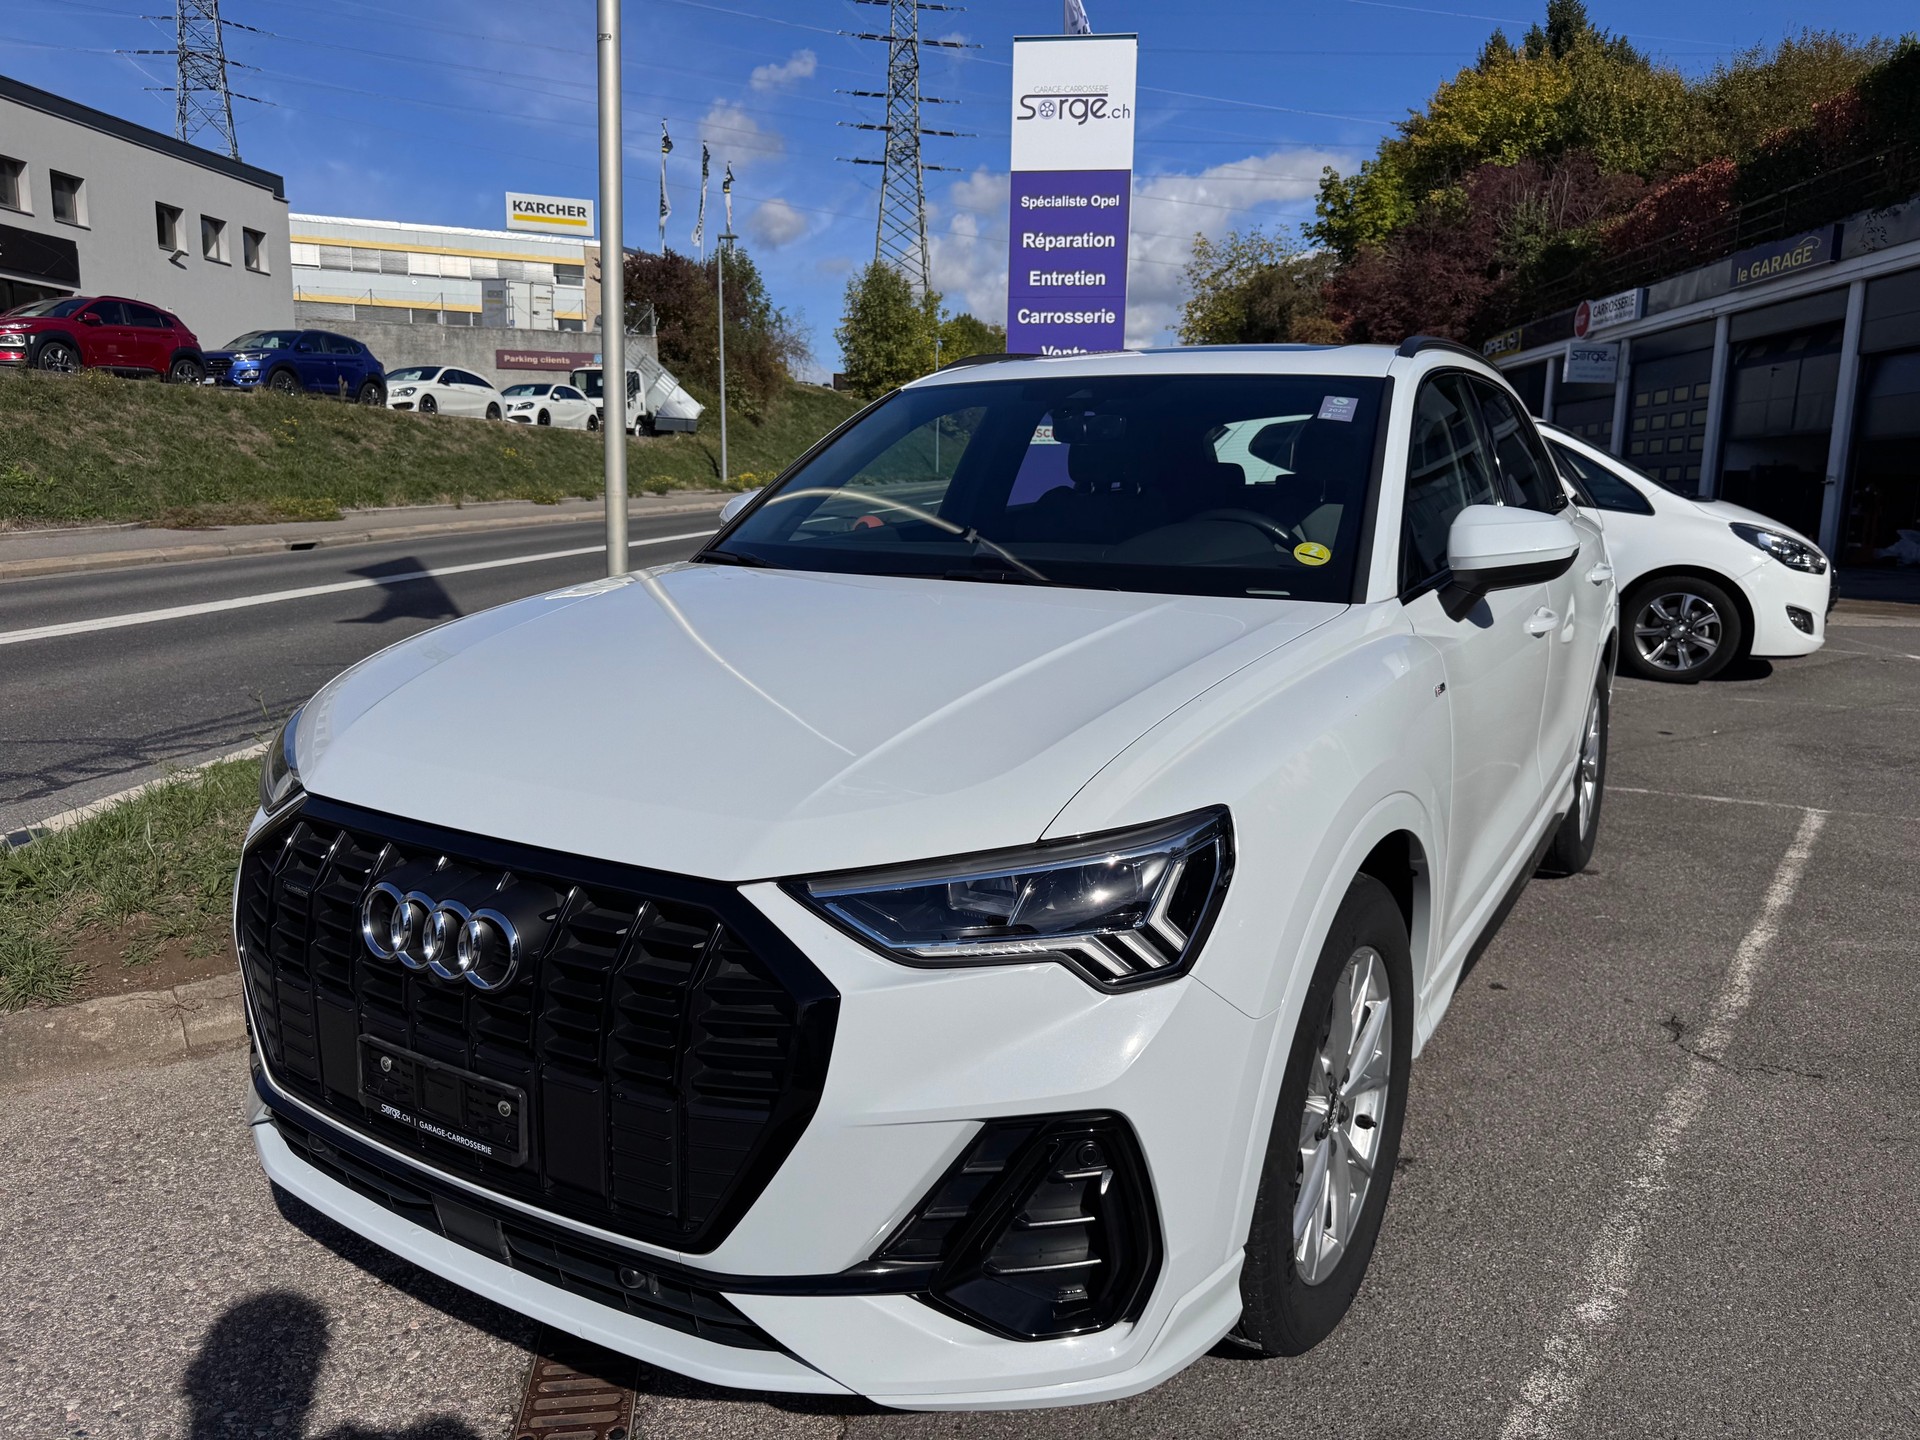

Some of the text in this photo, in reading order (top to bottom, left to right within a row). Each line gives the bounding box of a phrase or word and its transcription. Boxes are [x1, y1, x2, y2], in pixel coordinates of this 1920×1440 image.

[513, 201, 587, 217] KÄRCHER
[1020, 195, 1120, 209] Spécialiste Opel
[1022, 232, 1116, 251] Réparation
[1737, 245, 1814, 282] le GARAGE
[1029, 270, 1106, 286] Entretien
[1592, 293, 1635, 318] CARROSSERIE
[1017, 308, 1116, 324] Carrosserie
[1483, 336, 1507, 357] OPEL
[503, 354, 539, 365] Parking
[540, 356, 571, 365] clients
[419, 1119, 493, 1155] GARAGE-CARROSSERIE
